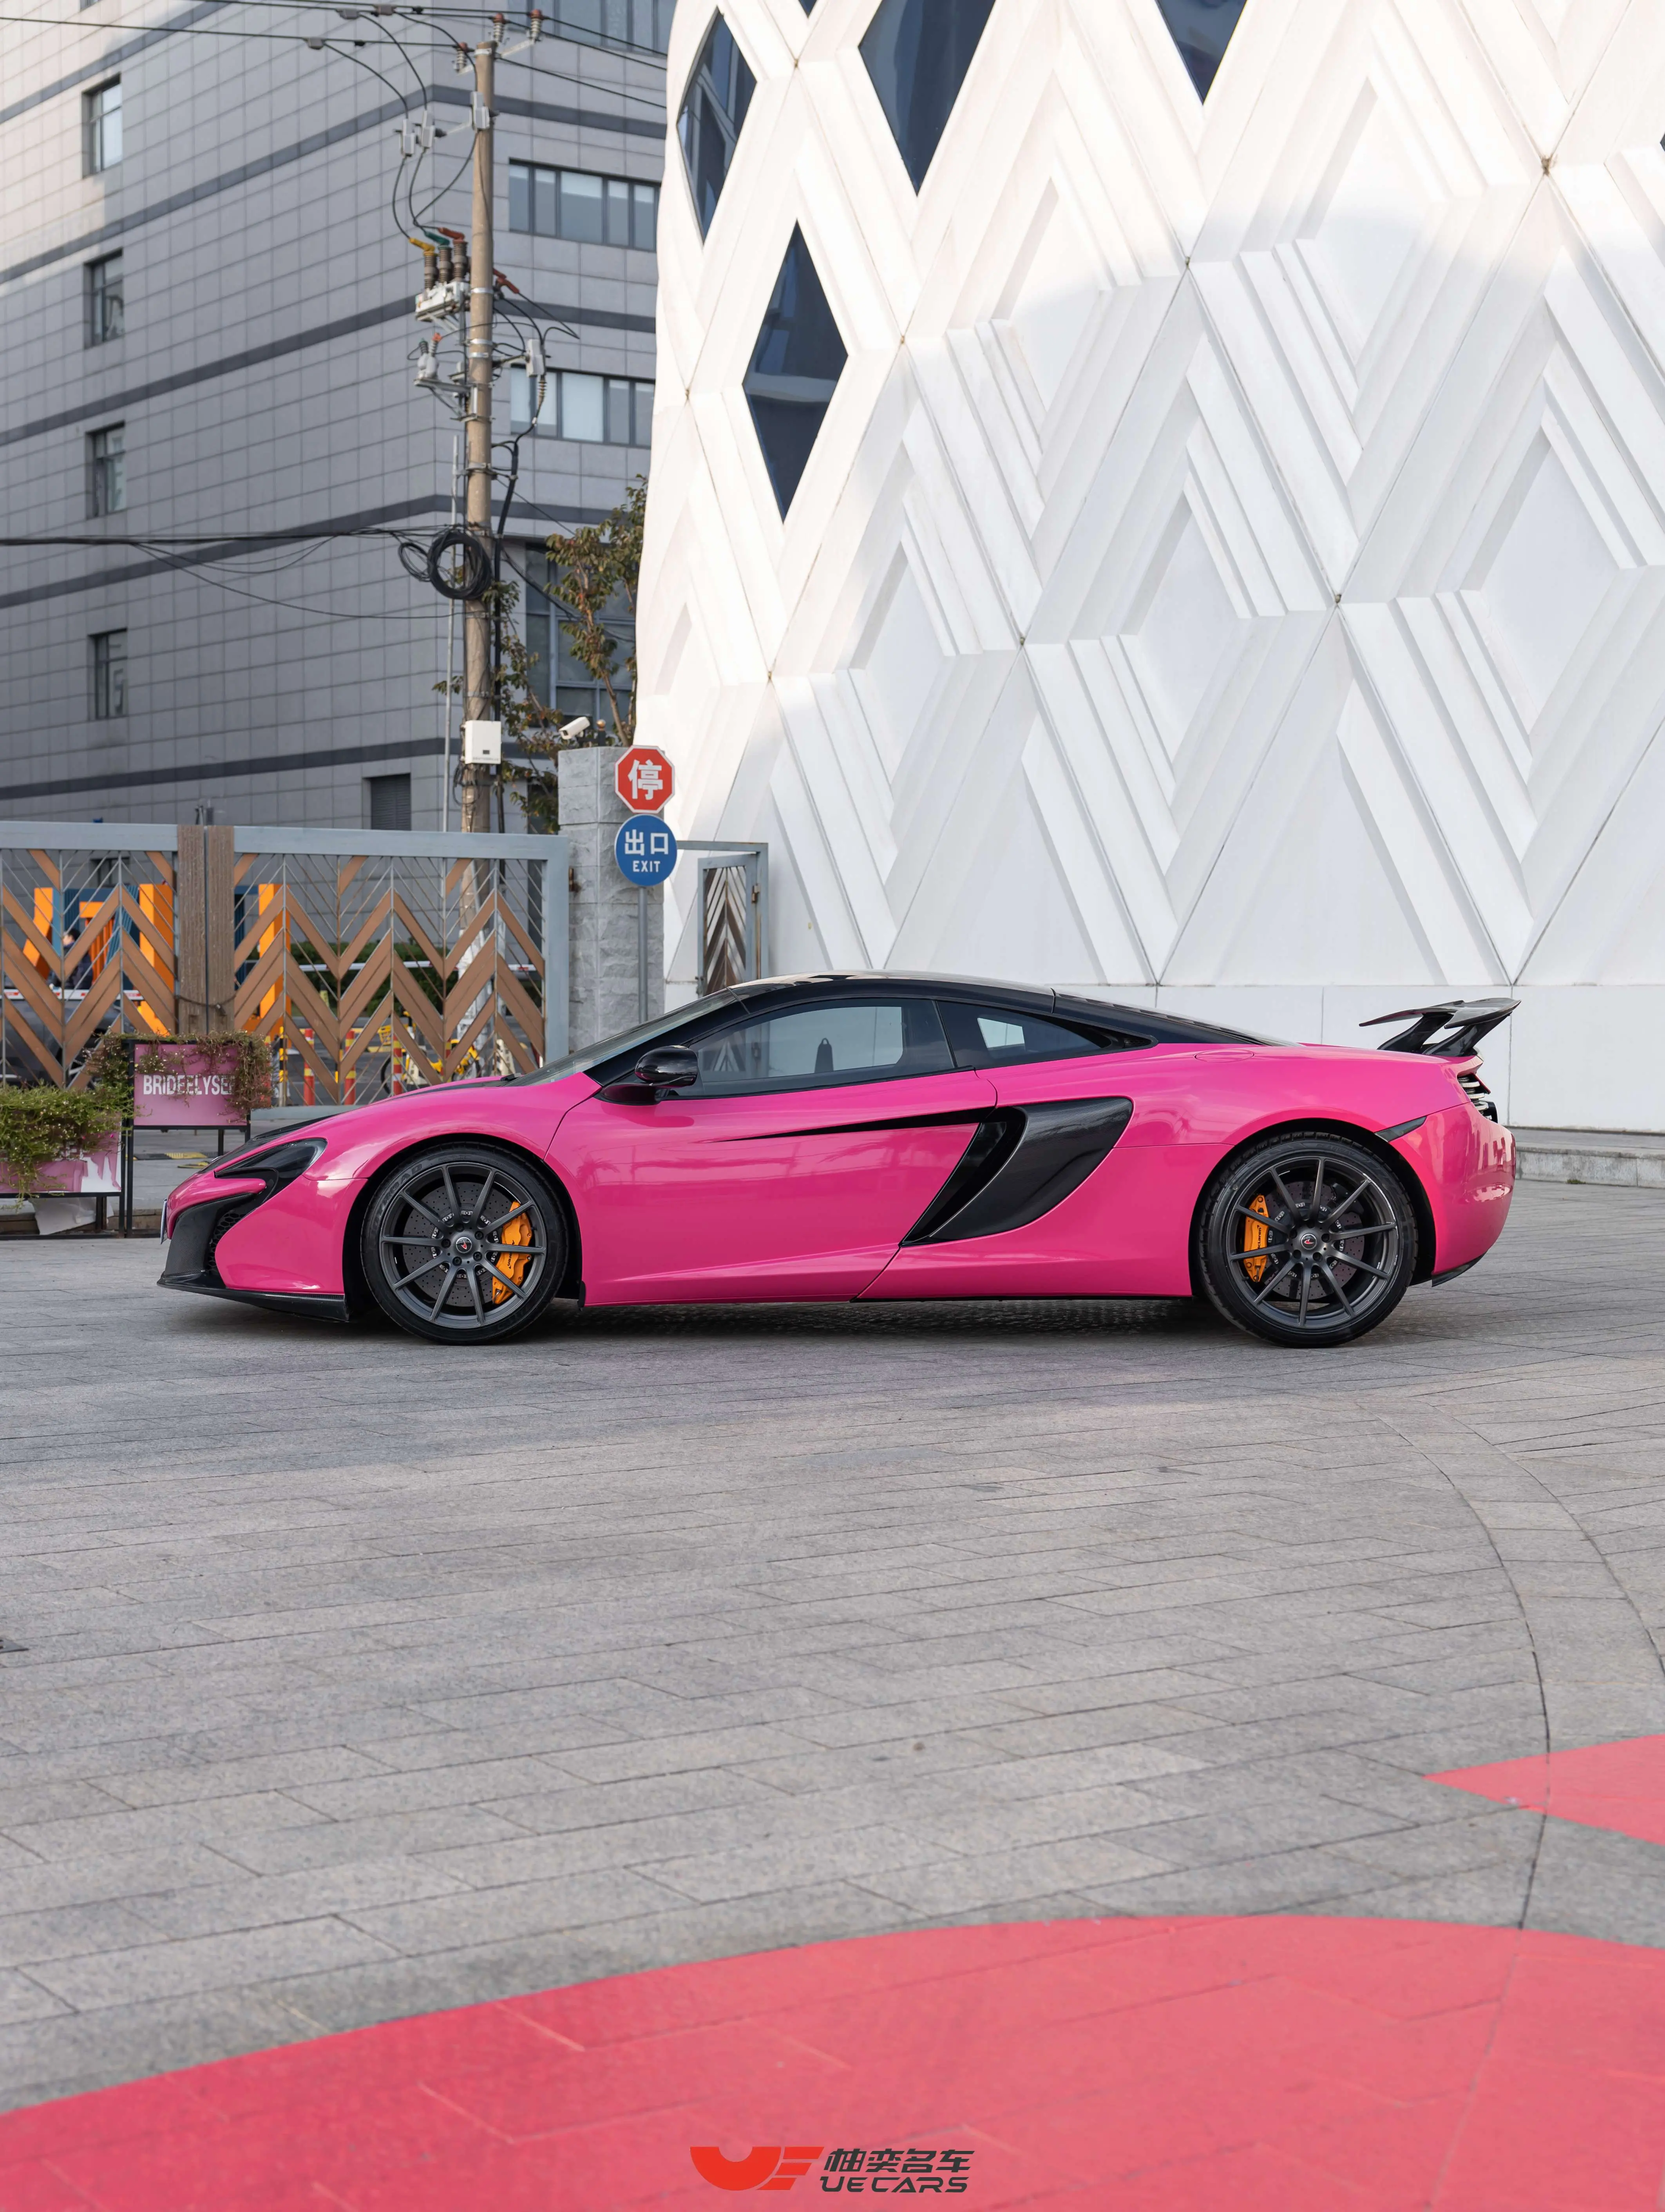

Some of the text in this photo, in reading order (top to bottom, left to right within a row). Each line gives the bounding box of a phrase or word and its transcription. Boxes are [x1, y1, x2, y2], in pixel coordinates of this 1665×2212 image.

[628, 759, 663, 800] 停
[624, 829, 668, 856] 出口
[633, 860, 661, 872] EXIT
